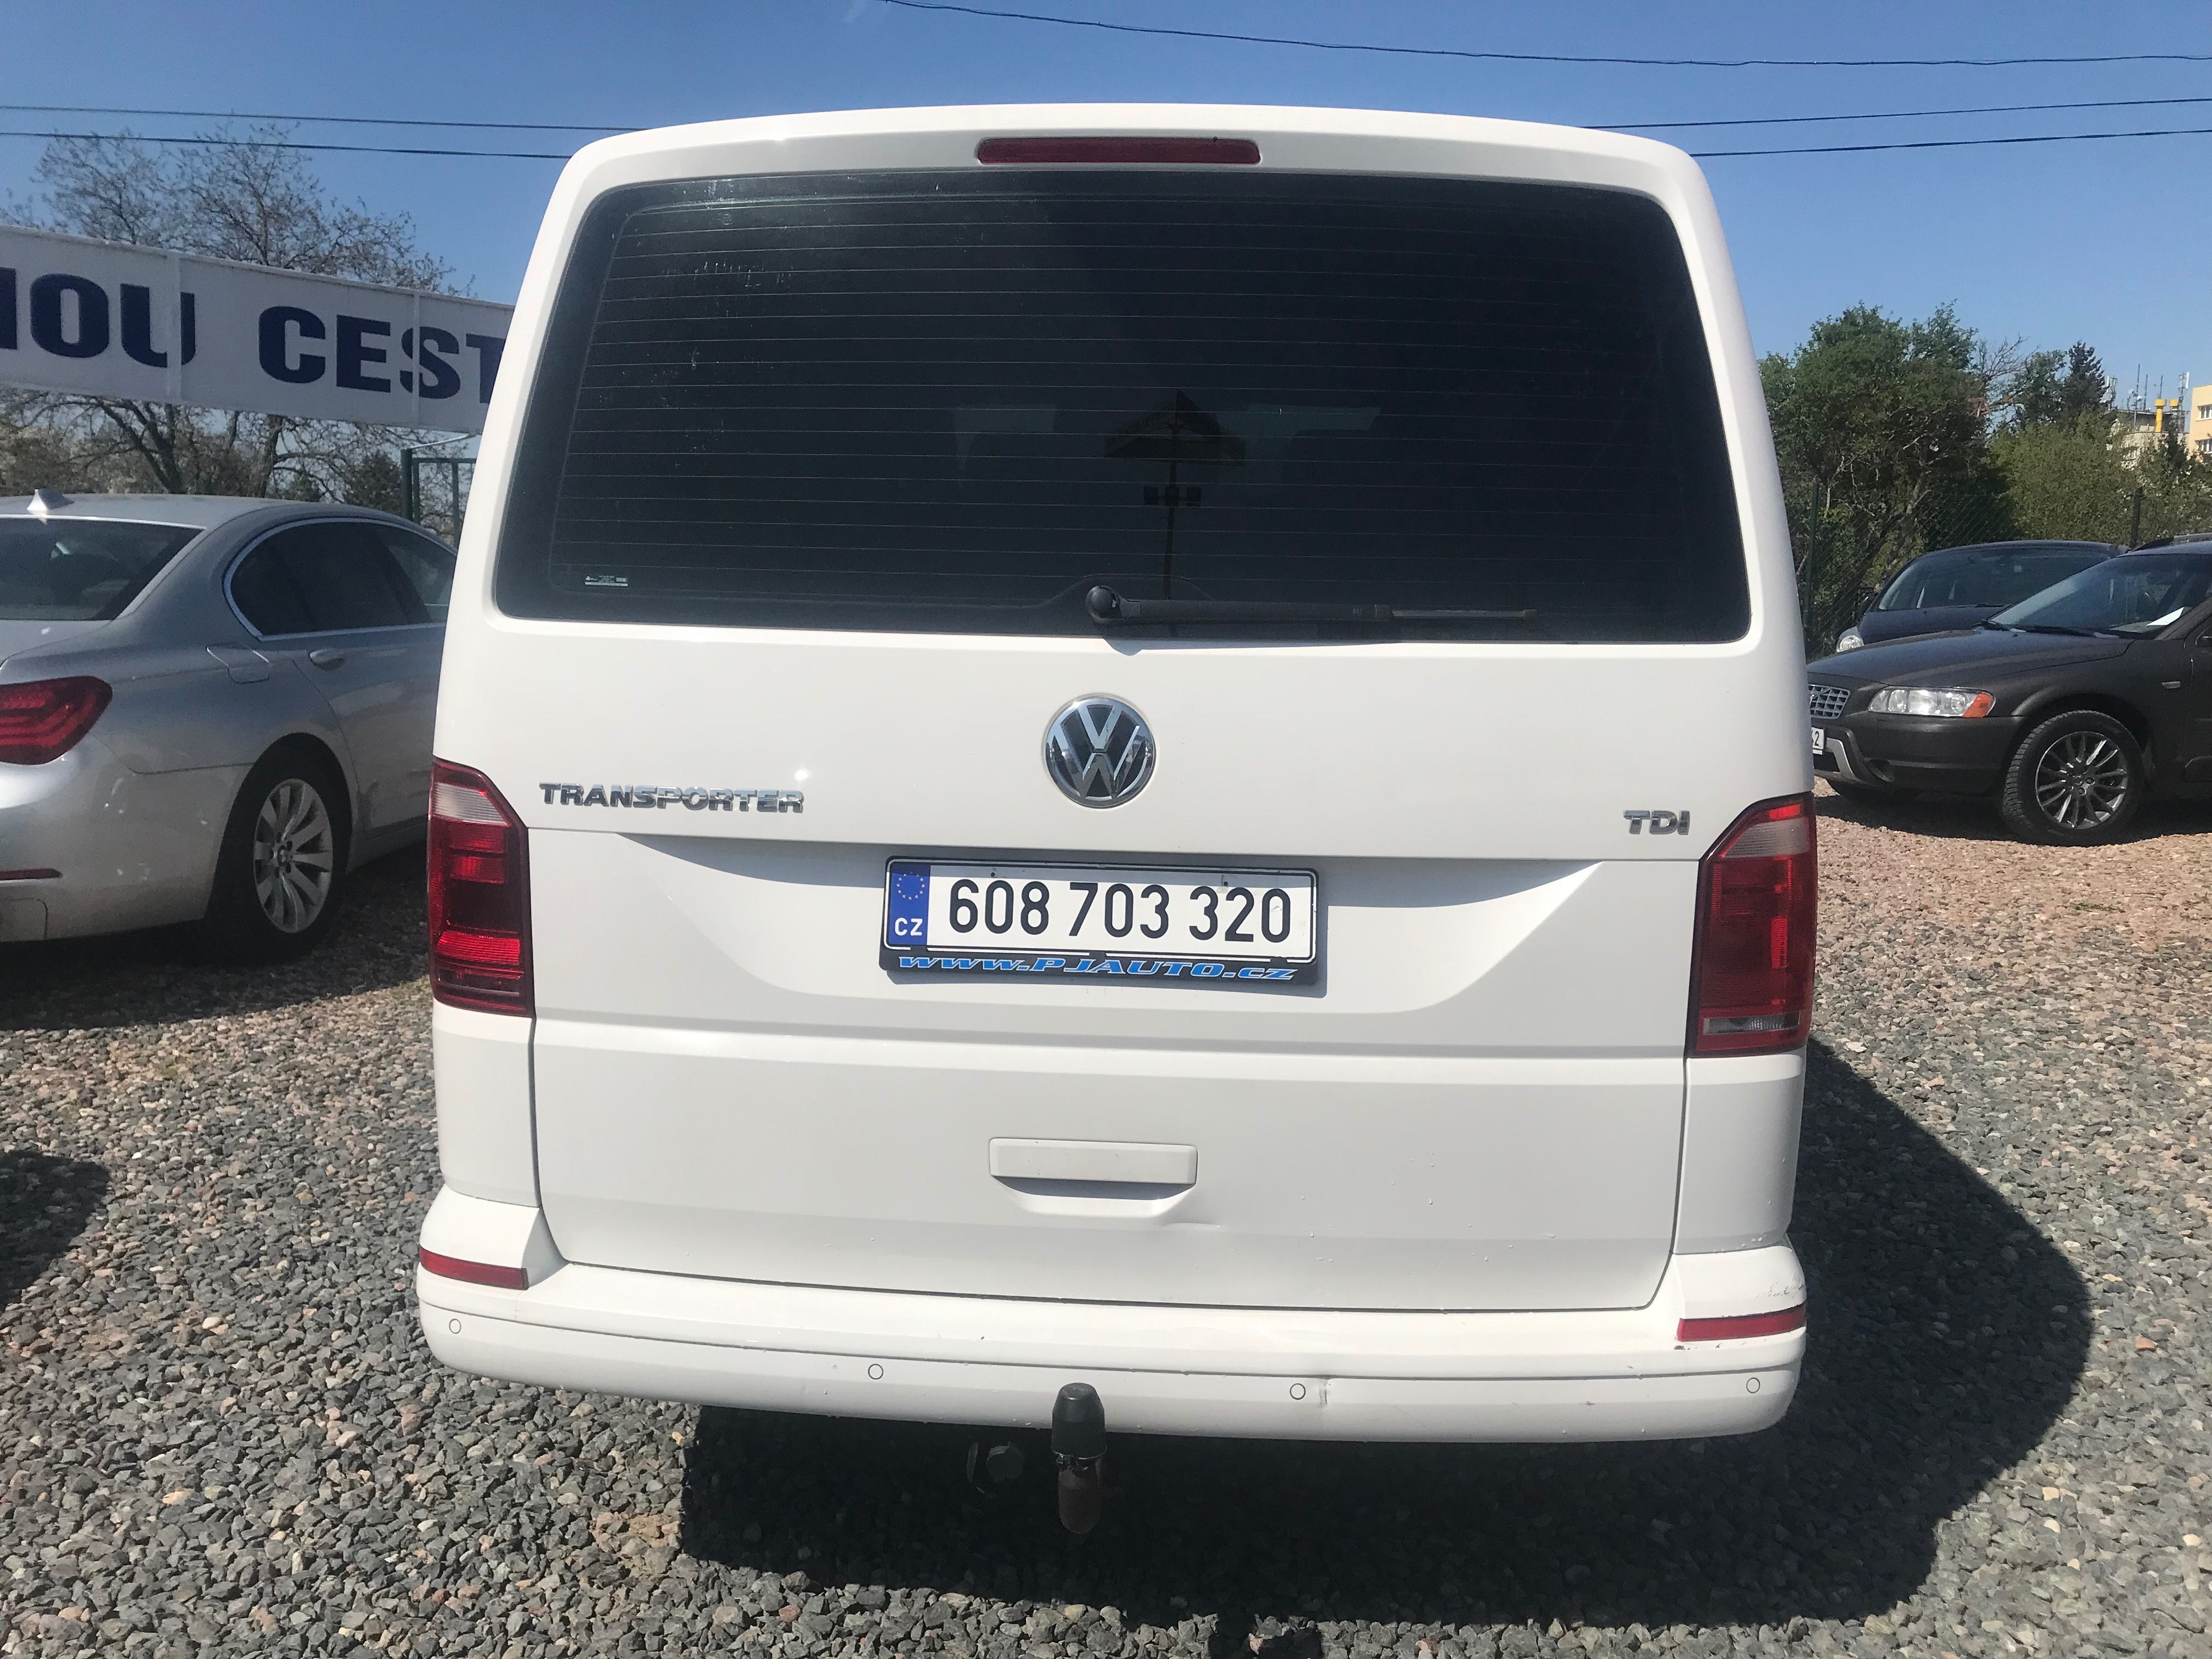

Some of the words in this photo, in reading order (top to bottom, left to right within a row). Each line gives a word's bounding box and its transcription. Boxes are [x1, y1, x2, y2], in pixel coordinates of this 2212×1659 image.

[1047, 699, 1154, 808] VW
[539, 782, 804, 813] TRANSPORTER
[1623, 810, 1690, 835] TDI
[949, 879, 1049, 935] 608
[1069, 882, 1169, 939] 703
[1189, 887, 1290, 943] 320
[895, 918, 923, 937] CZ
